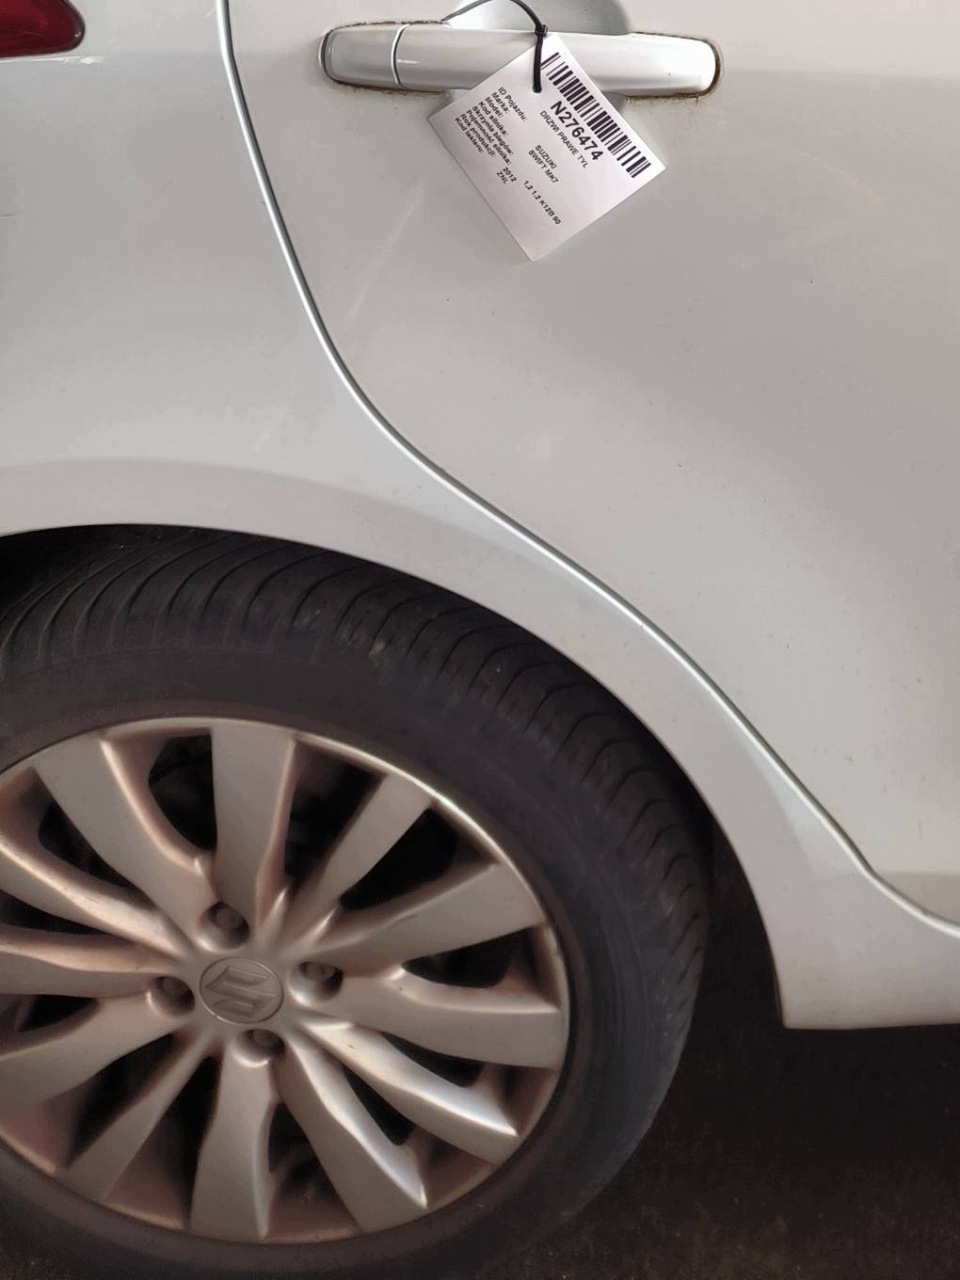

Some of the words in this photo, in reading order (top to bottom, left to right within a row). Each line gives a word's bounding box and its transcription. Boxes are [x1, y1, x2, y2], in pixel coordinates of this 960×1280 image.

[478, 101, 491, 115] Kod
[485, 96, 504, 118] Model:
[492, 92, 510, 113] Marka:
[498, 86, 507, 96] ID
[504, 95, 528, 122] Pojazdu:
[455, 117, 467, 131] Kod
[460, 113, 472, 127] Rok
[472, 105, 495, 132] Skrzynia
[550, 100, 604, 161] N276474
[540, 110, 560, 132] DRZWI
[557, 131, 579, 156] PRAWE
[528, 149, 547, 170] SWIFT
[544, 169, 559, 184] MK7
[535, 144, 557, 170] SUZUKI
[502, 166, 517, 183] 2012
